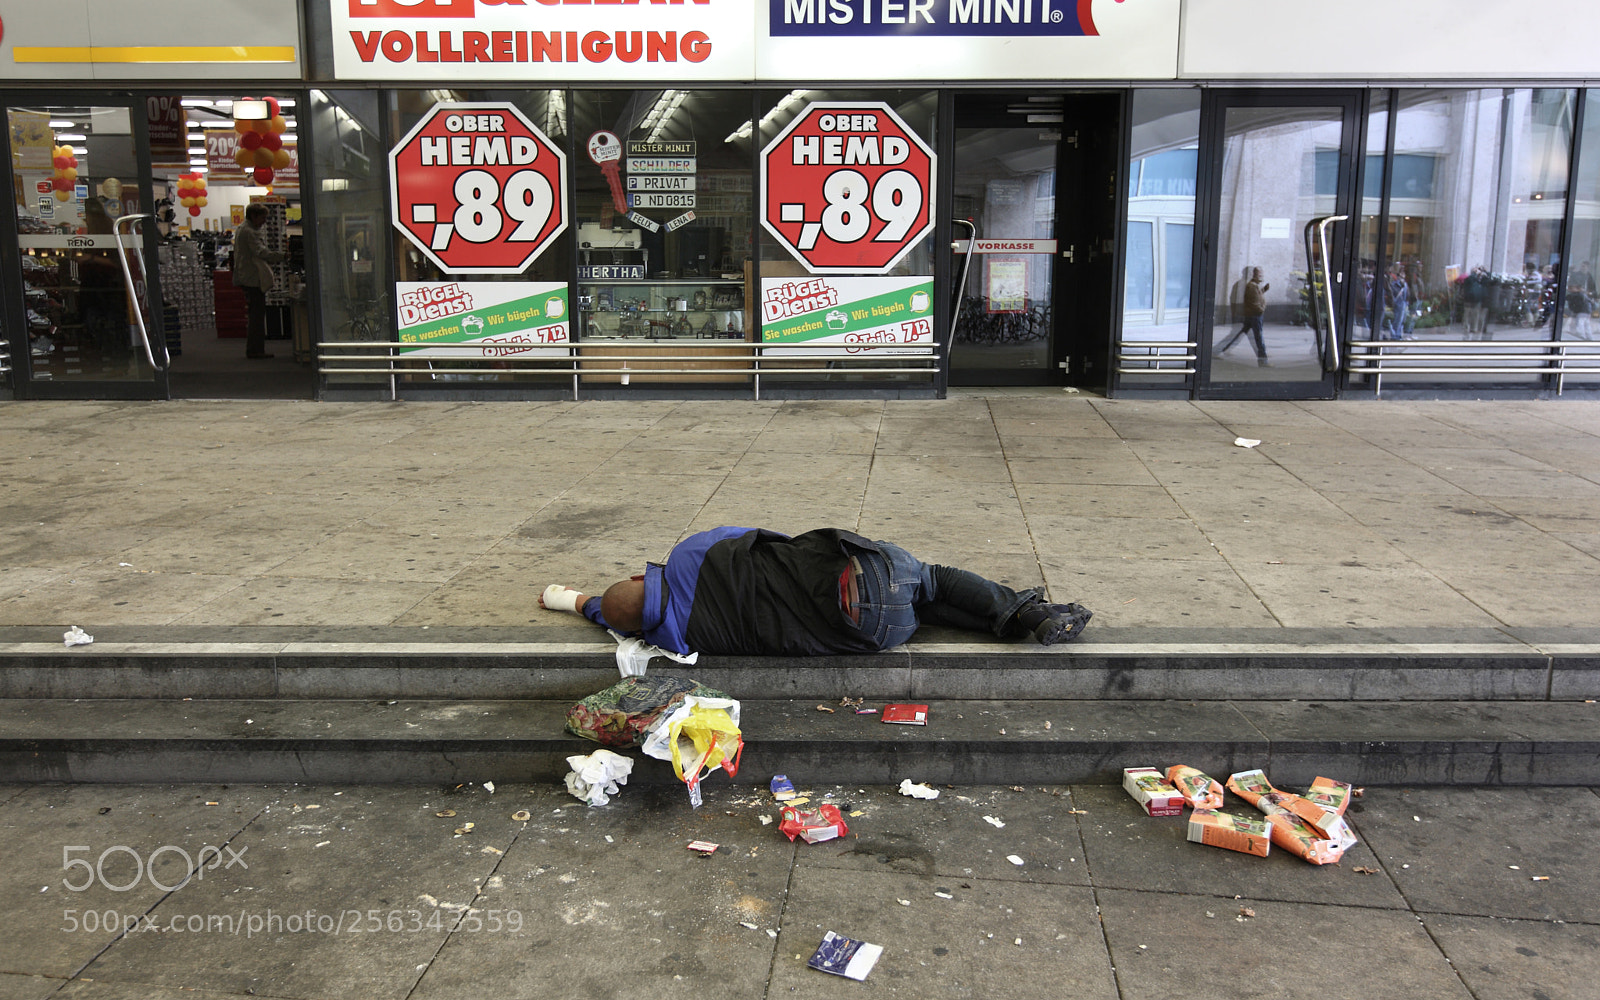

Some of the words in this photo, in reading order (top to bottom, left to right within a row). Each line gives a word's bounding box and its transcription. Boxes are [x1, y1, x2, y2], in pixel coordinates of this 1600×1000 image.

[784, 0, 935, 25] MISTER
[349, 30, 713, 63] VOLLREINIGUNG
[445, 114, 506, 133] OBER
[818, 113, 880, 133] OBER
[208, 137, 241, 156] 20%
[420, 136, 539, 167] HEMD
[632, 144, 663, 152] MISTER
[666, 144, 691, 152] MINIT
[792, 135, 911, 166] HEMD
[632, 160, 690, 171] SCHILDER
[644, 178, 687, 189] PRIVAT
[634, 196, 641, 206] B
[633, 214, 653, 229] FELIX
[669, 216, 689, 230] LENA
[67, 239, 95, 247] RENO
[582, 267, 639, 278] HERTHA
[399, 292, 473, 326] Dienst
[764, 287, 838, 321] Dienst
[401, 334, 417, 343] Sie
[419, 325, 460, 341] waschen
[487, 314, 505, 326] Wir
[507, 308, 540, 323] bügeln
[765, 330, 780, 340] Sie
[782, 321, 823, 337] waschen
[851, 309, 869, 321] Wir
[871, 302, 905, 318] bügeln
